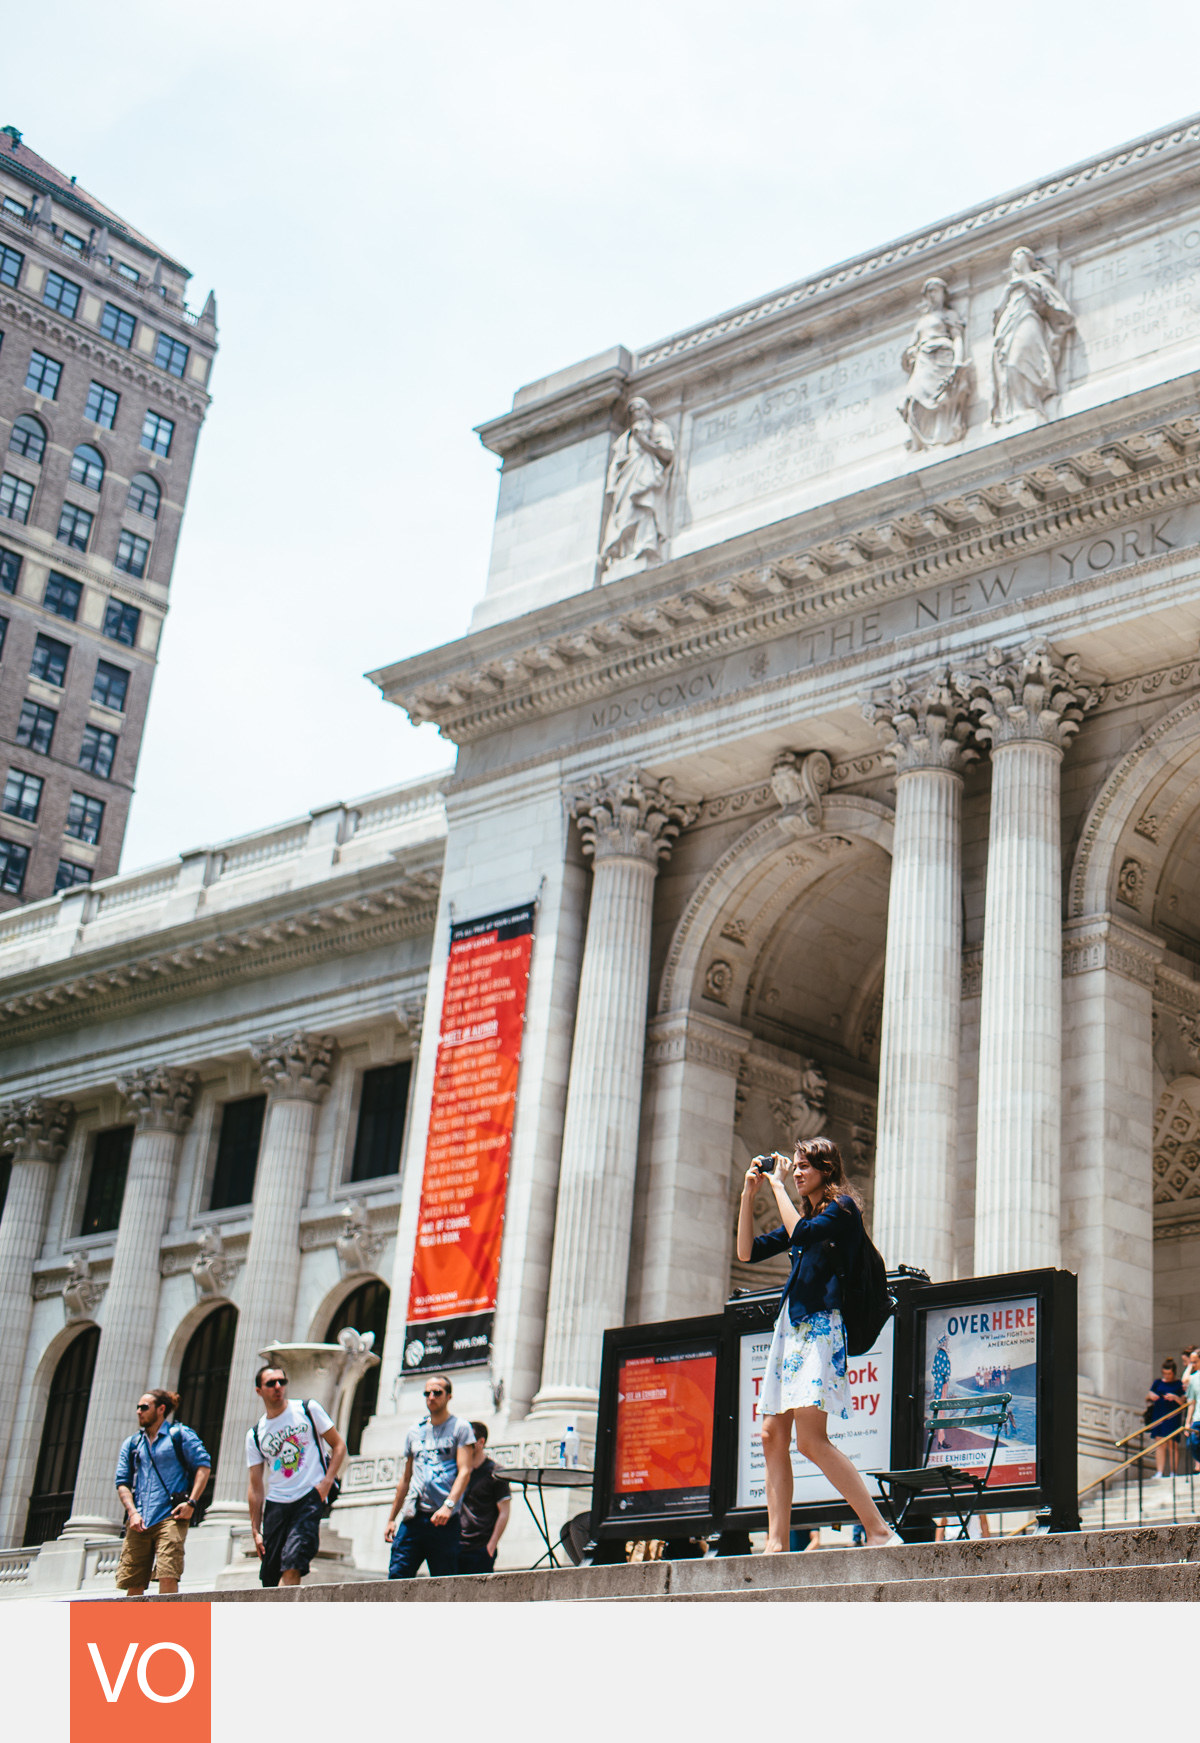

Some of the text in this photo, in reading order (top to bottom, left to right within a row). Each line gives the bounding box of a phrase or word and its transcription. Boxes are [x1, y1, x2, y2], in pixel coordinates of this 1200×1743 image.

[1086, 256, 1129, 290] THE
[1138, 274, 1196, 307] JAMES
[1115, 292, 1193, 330] DEDICATED
[703, 348, 902, 441] THE ASTOR LIBRARY
[827, 397, 871, 426] ASTOR
[591, 671, 725, 729] MDCCCXCV
[802, 612, 883, 665] THE
[915, 567, 1018, 628] NEW
[1059, 516, 1176, 581] YORK
[987, 1337, 1035, 1348] AMERICAN MIND
[1006, 1330, 1024, 1338] FIGHT
[945, 1452, 987, 1462] EXHIBITION
